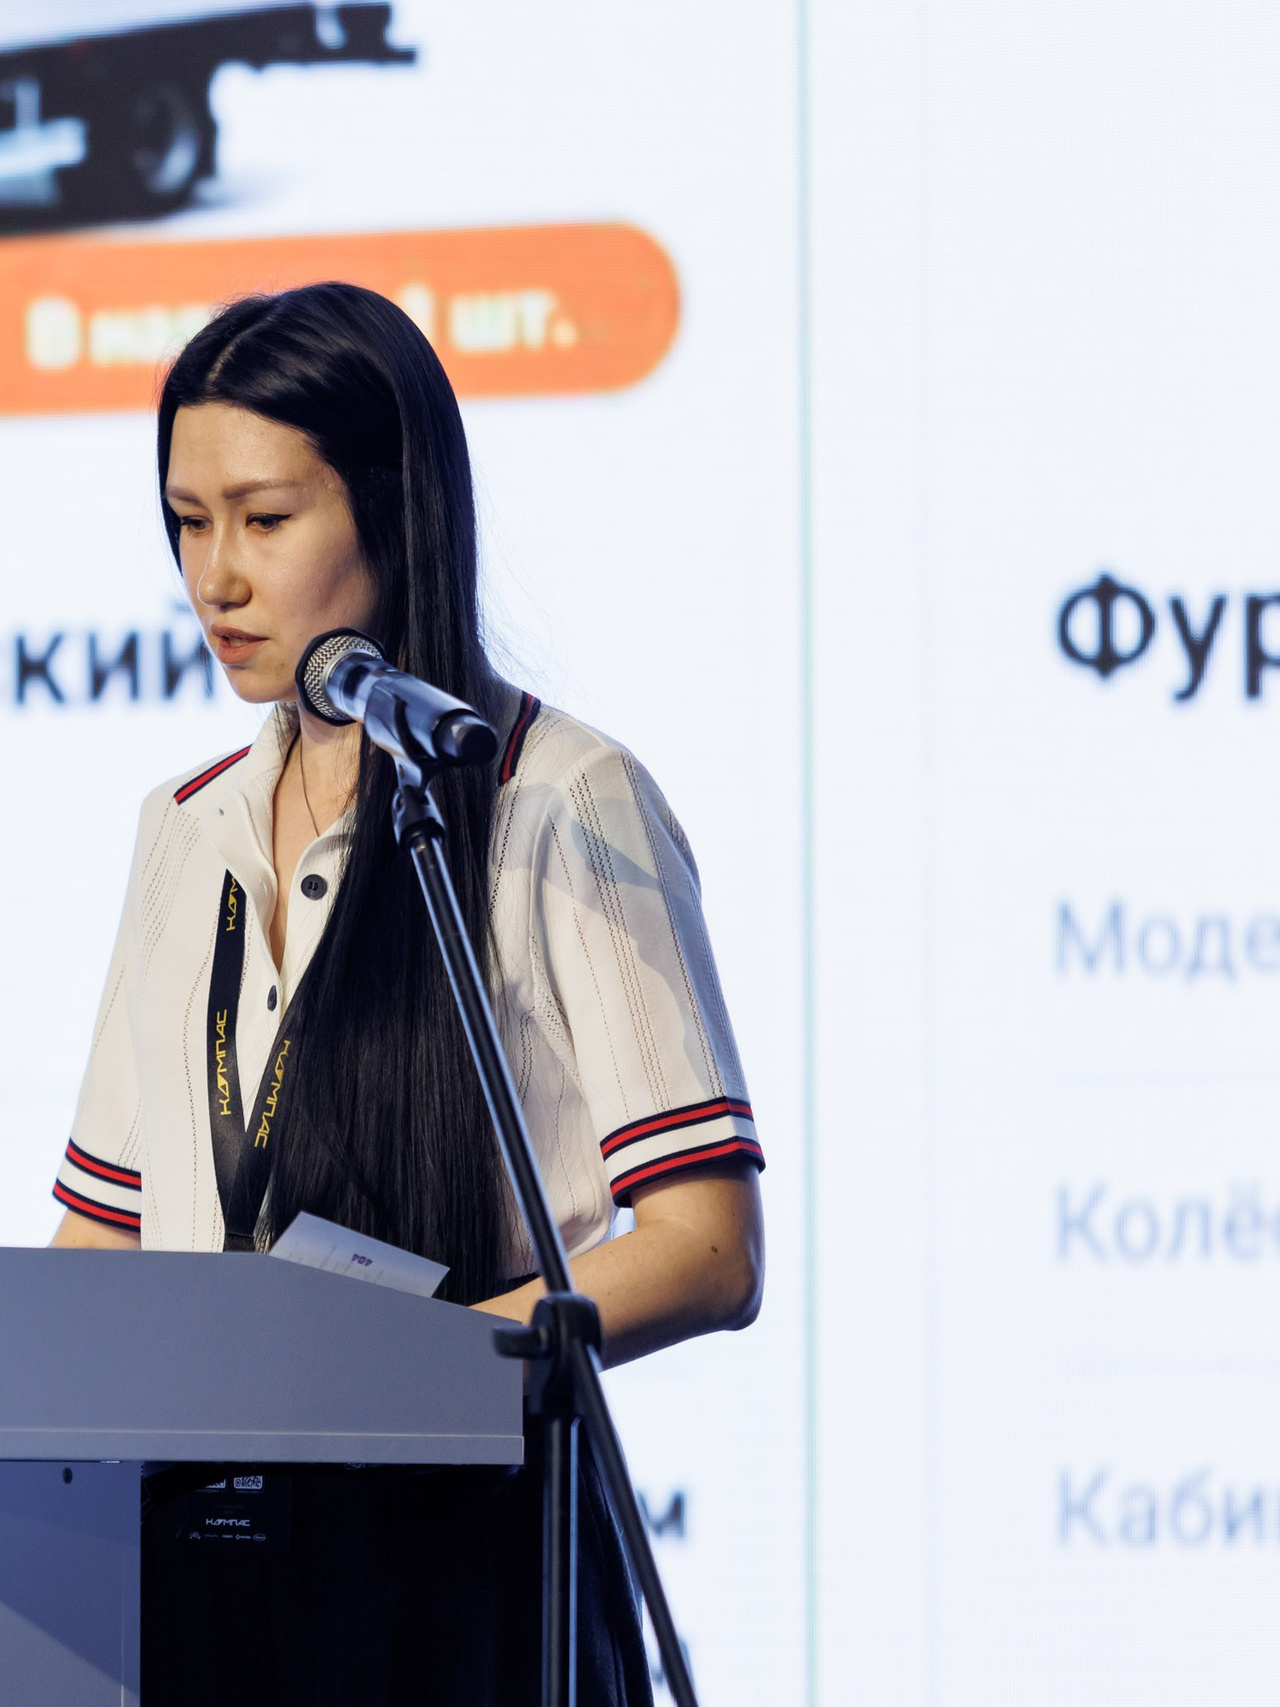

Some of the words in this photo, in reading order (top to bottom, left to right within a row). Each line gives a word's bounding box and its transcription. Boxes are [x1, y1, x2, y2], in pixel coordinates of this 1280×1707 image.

[1056, 571, 1280, 703] Фур
[1054, 897, 1280, 984] Моде
[1055, 1181, 1280, 1264] Колё
[1056, 1467, 1280, 1548] Каби
